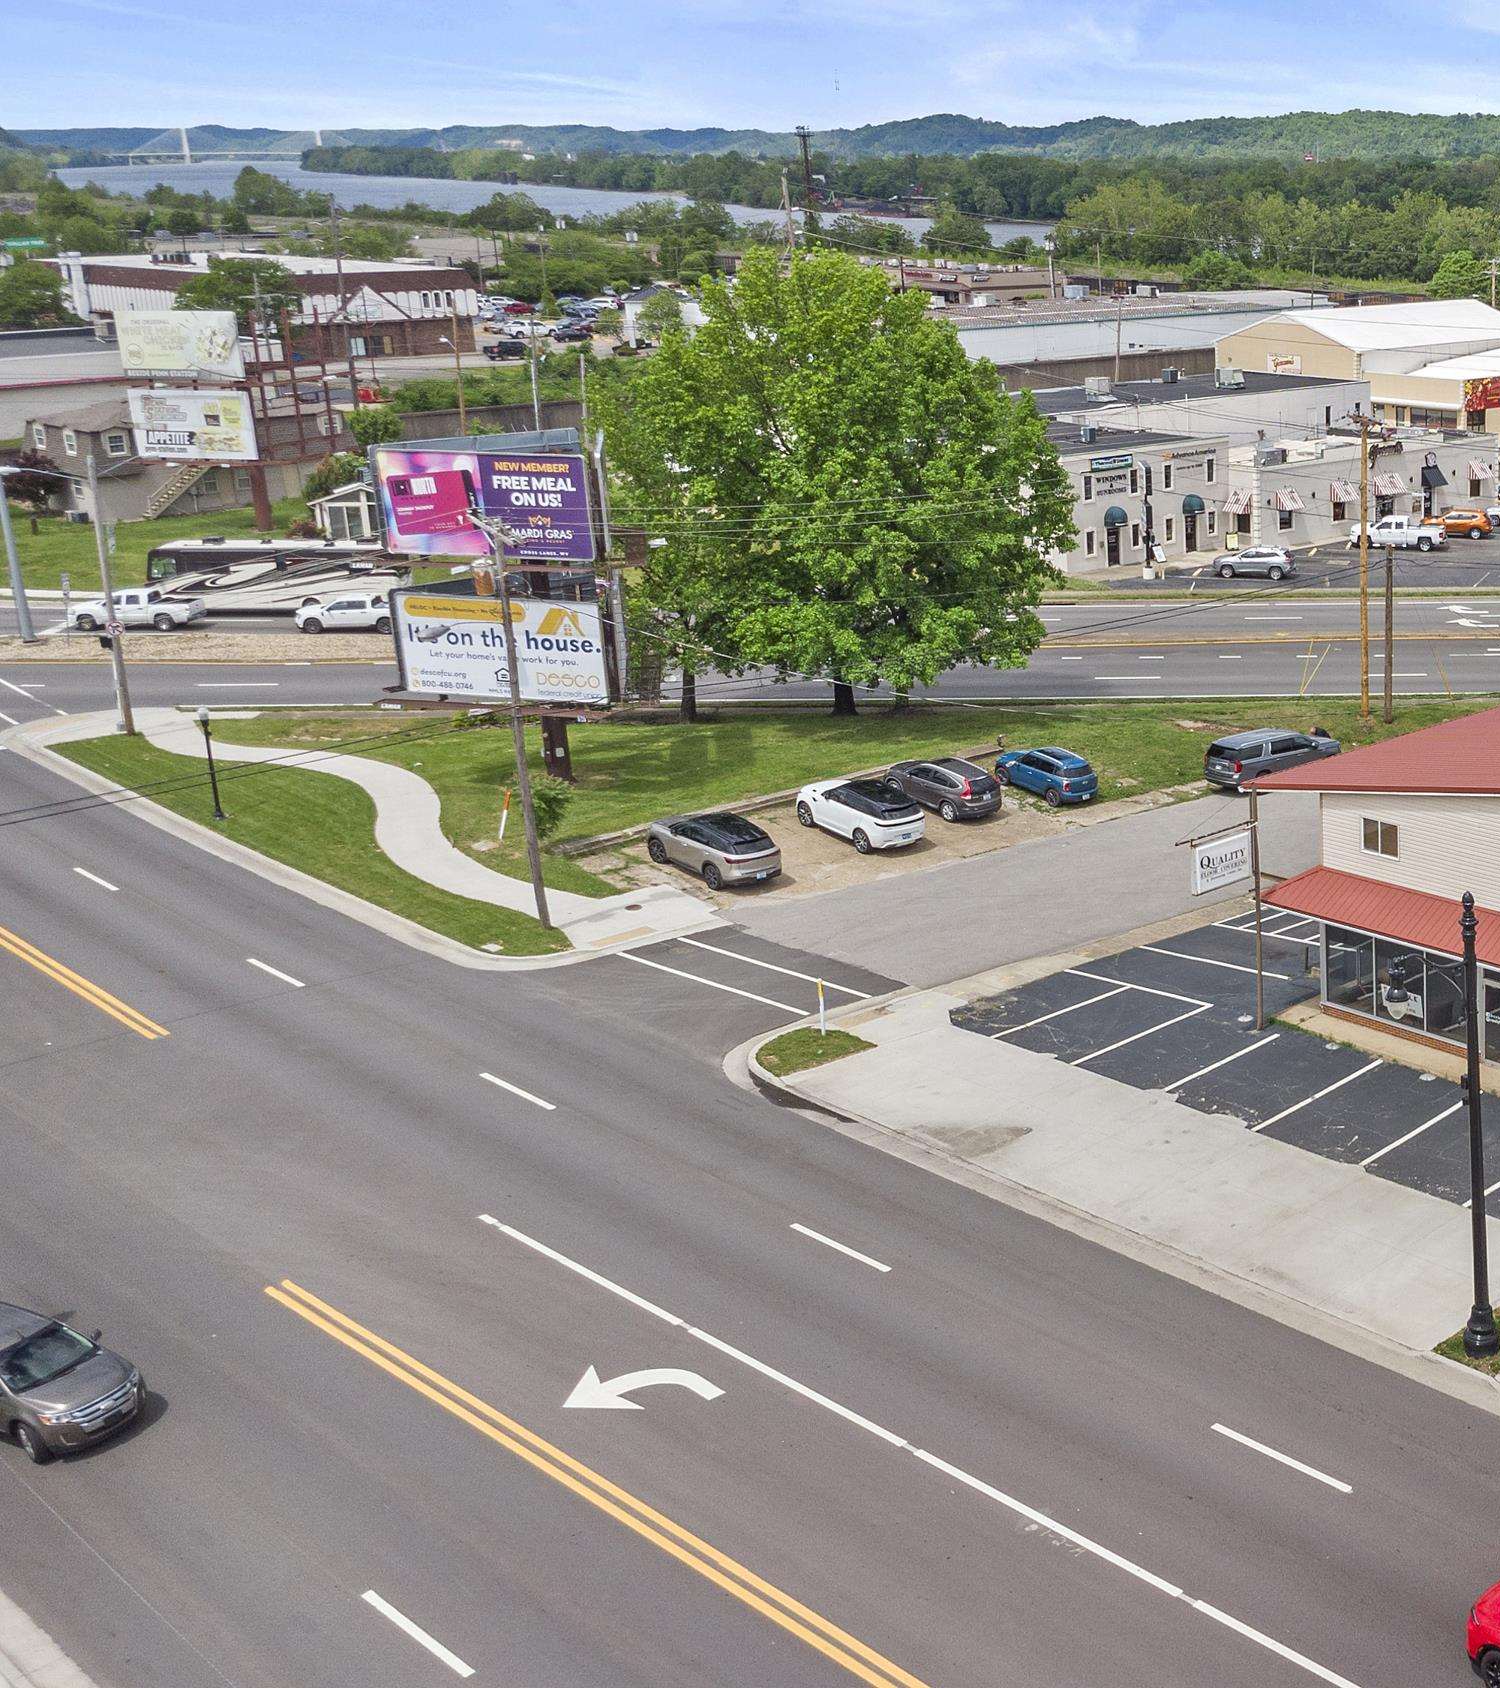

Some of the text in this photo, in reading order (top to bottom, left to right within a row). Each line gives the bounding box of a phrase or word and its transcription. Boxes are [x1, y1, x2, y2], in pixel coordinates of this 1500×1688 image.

[148, 431, 190, 445] APPETITE
[494, 461, 569, 474] NEW MEMBER?
[492, 475, 577, 492] FREE MEAL
[1096, 474, 1126, 483] WINDOWS
[510, 492, 563, 508] ON US!
[510, 528, 573, 540] MARDI GRAS
[447, 632, 473, 646] on
[483, 629, 517, 648] th
[525, 630, 601, 653] house.
[429, 650, 443, 658] Let
[445, 652, 464, 661] your
[467, 652, 495, 661] home's
[522, 656, 542, 664] work
[545, 657, 557, 665] for
[560, 659, 579, 667] you.
[421, 669, 467, 680] descofcu.org
[421, 680, 474, 690] 800-488-0746
[537, 688, 561, 697] federal
[563, 690, 582, 698] credit
[1200, 849, 1245, 869] QUALITY
